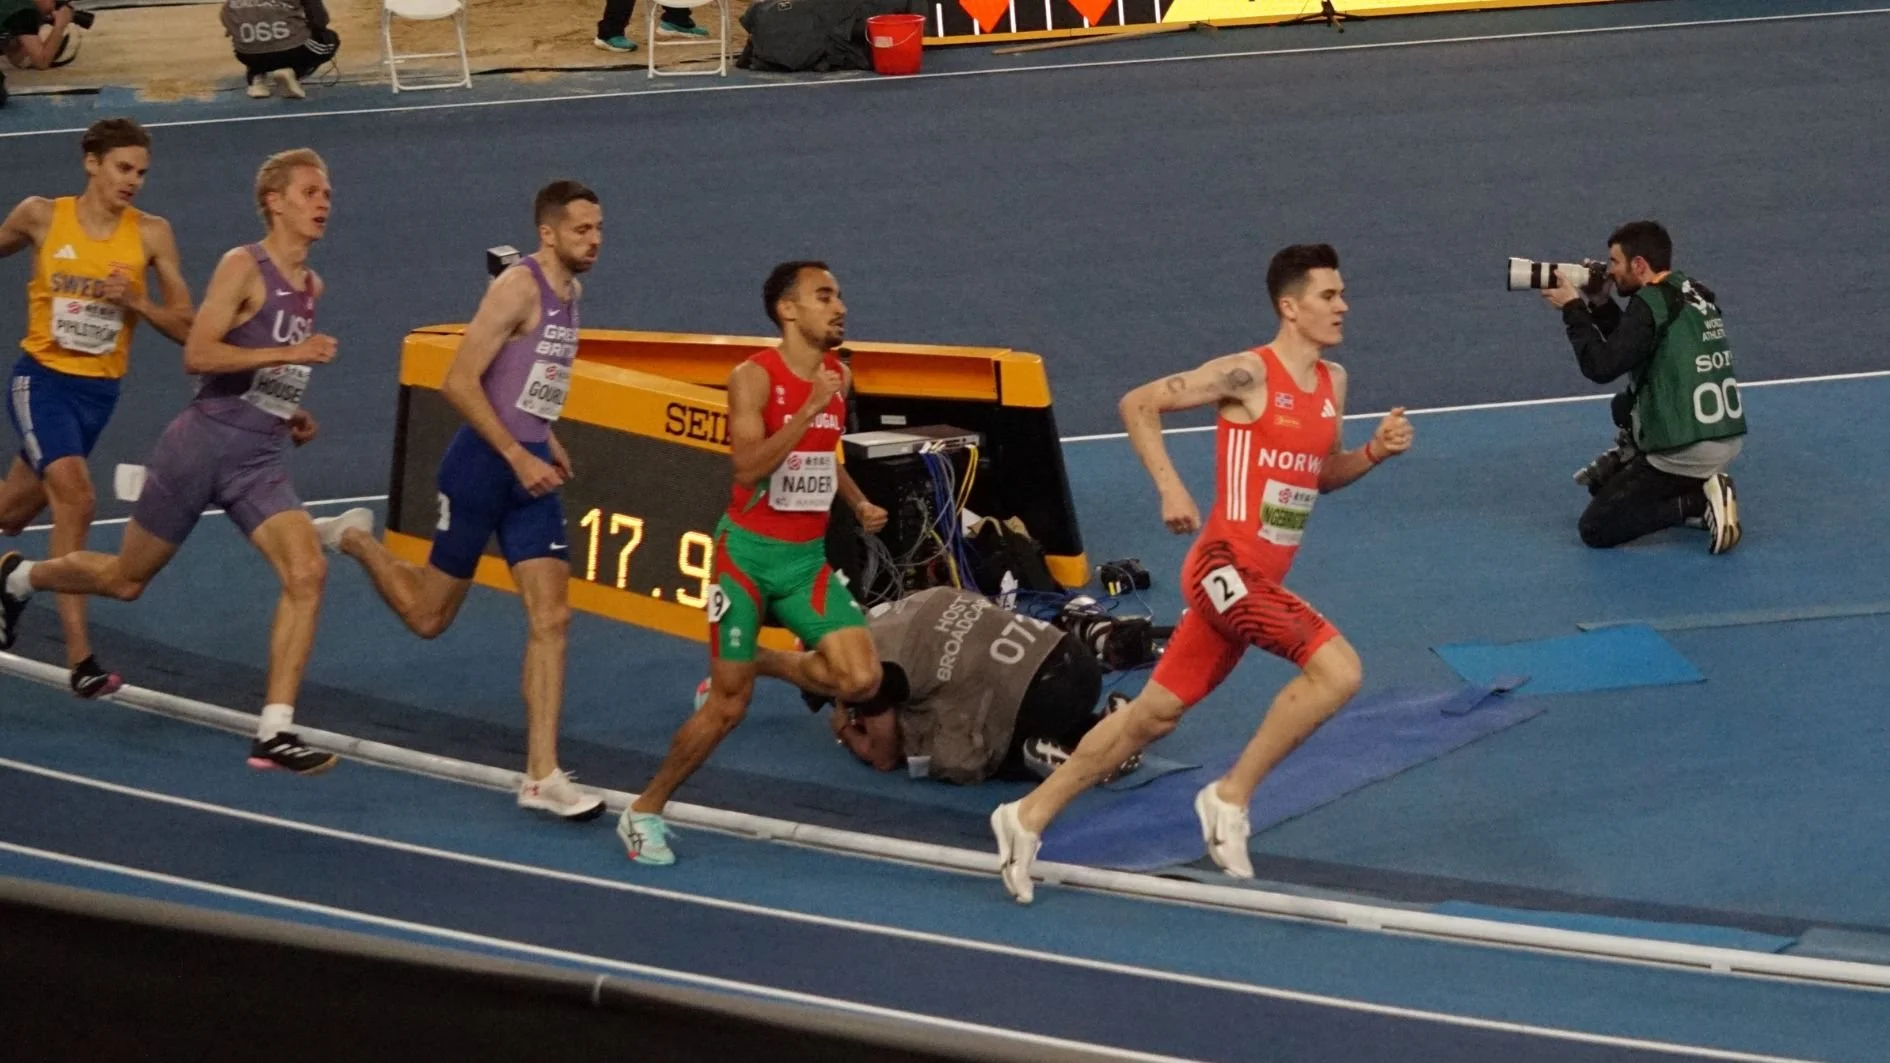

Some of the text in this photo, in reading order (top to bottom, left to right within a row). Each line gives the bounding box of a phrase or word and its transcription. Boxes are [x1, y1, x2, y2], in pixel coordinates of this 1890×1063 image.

[240, 21, 291, 43] 066
[782, 475, 833, 494] NADER
[579, 507, 713, 609] 17.9
[1212, 575, 1235, 602] 2
[713, 590, 724, 617] 9
[934, 595, 970, 633] HOST
